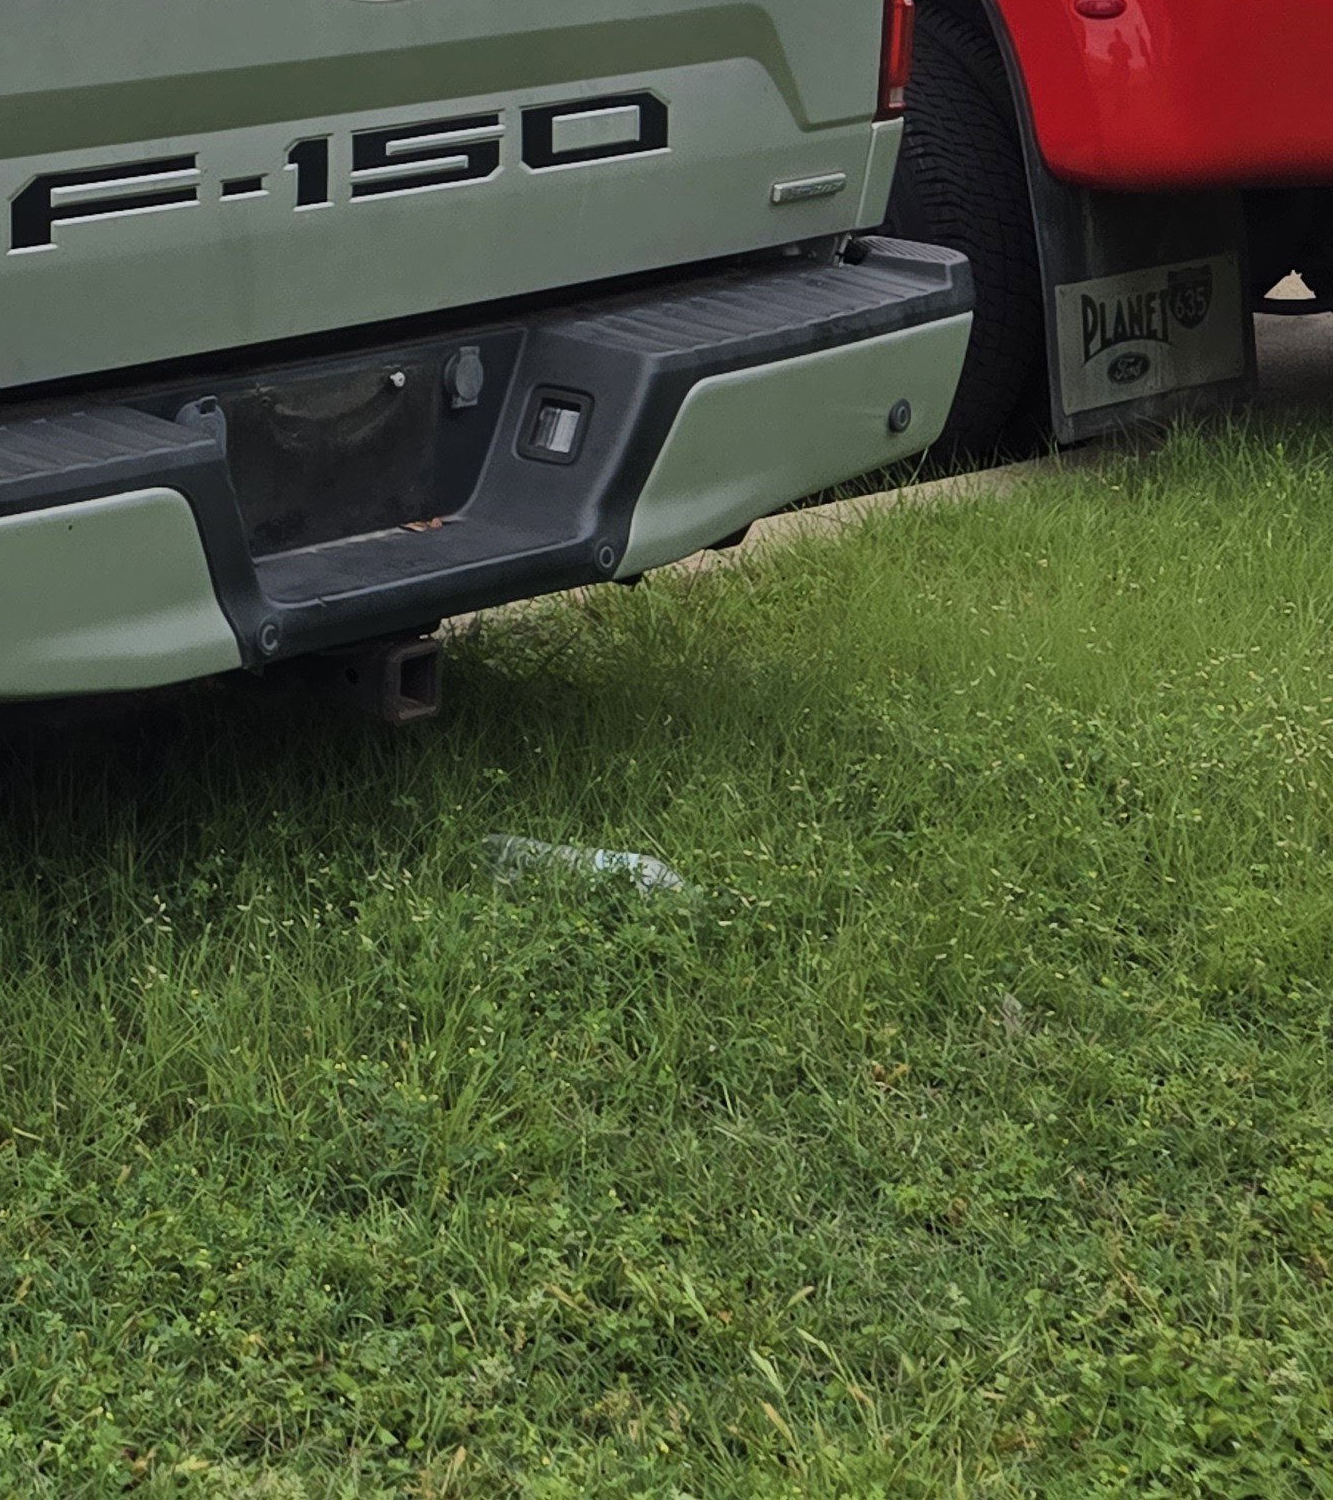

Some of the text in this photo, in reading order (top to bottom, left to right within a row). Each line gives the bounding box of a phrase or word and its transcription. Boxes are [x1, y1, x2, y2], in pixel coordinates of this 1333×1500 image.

[7, 87, 672, 256] F-150
[1081, 287, 1209, 365] PLANET 635
